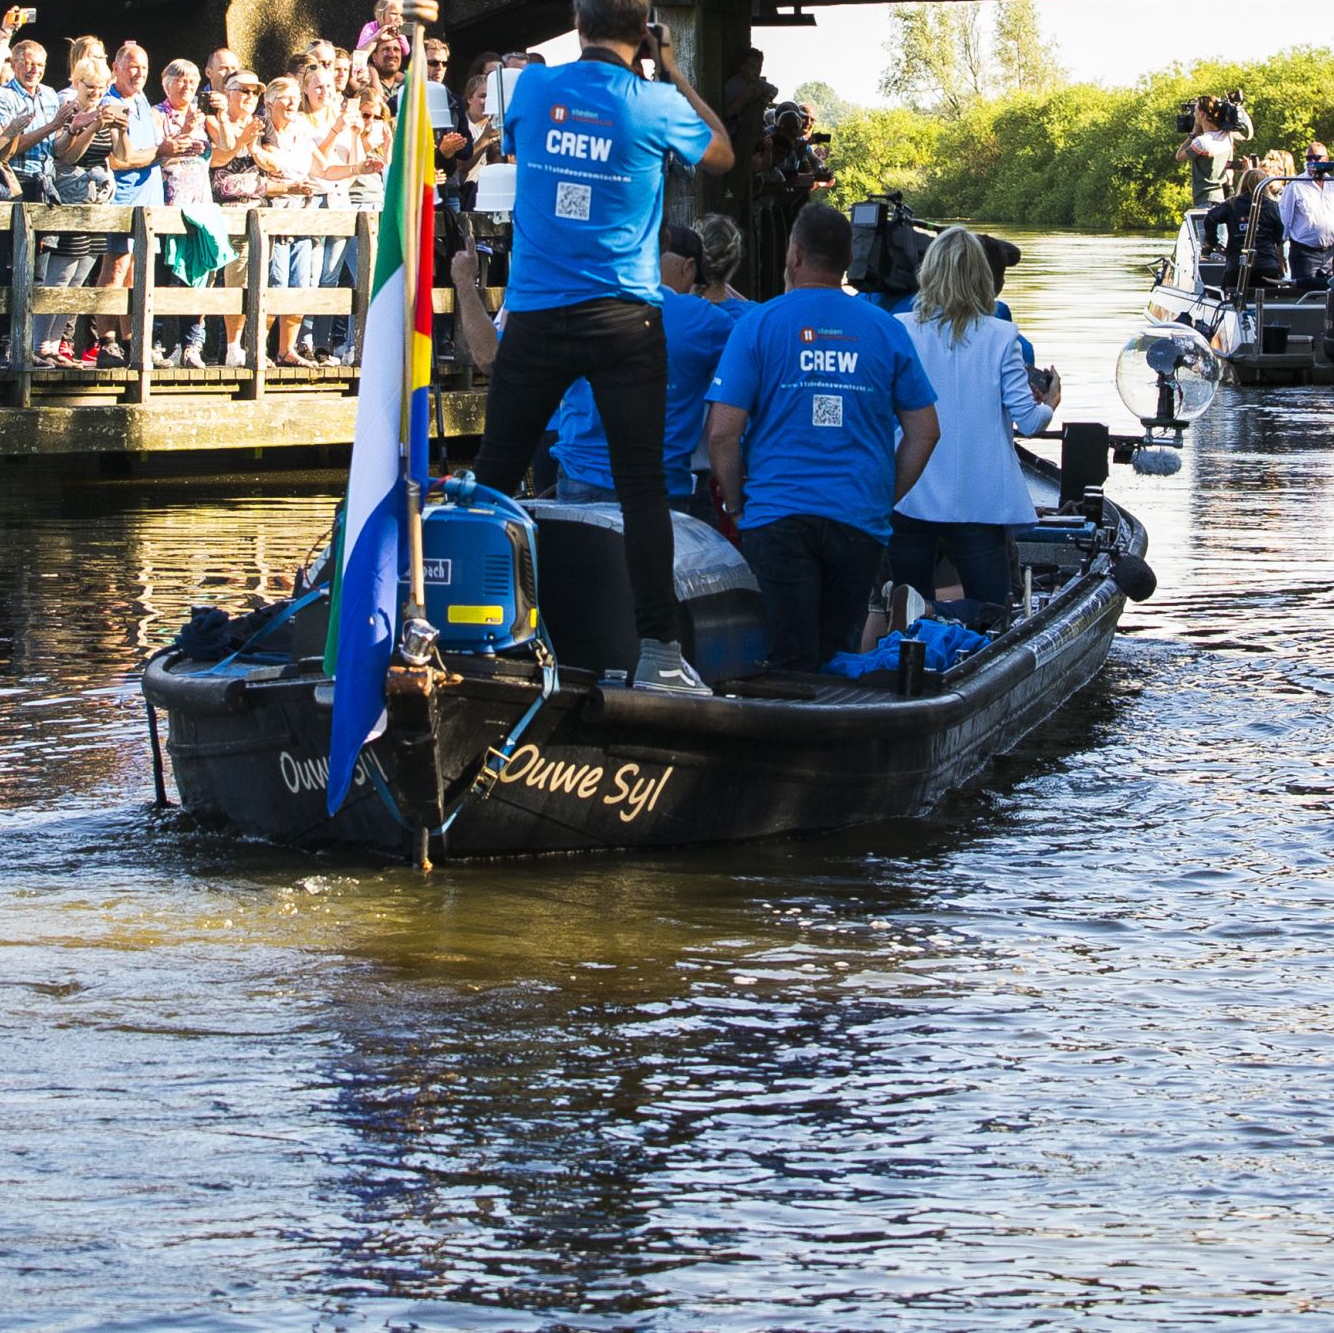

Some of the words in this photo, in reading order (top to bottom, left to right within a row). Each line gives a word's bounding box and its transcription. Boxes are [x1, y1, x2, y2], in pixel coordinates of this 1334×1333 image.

[546, 129, 612, 162] CREW
[800, 350, 858, 373] CREW
[280, 751, 331, 793] Ouw
[500, 744, 604, 798] Ouwe
[603, 763, 673, 822] Syl
